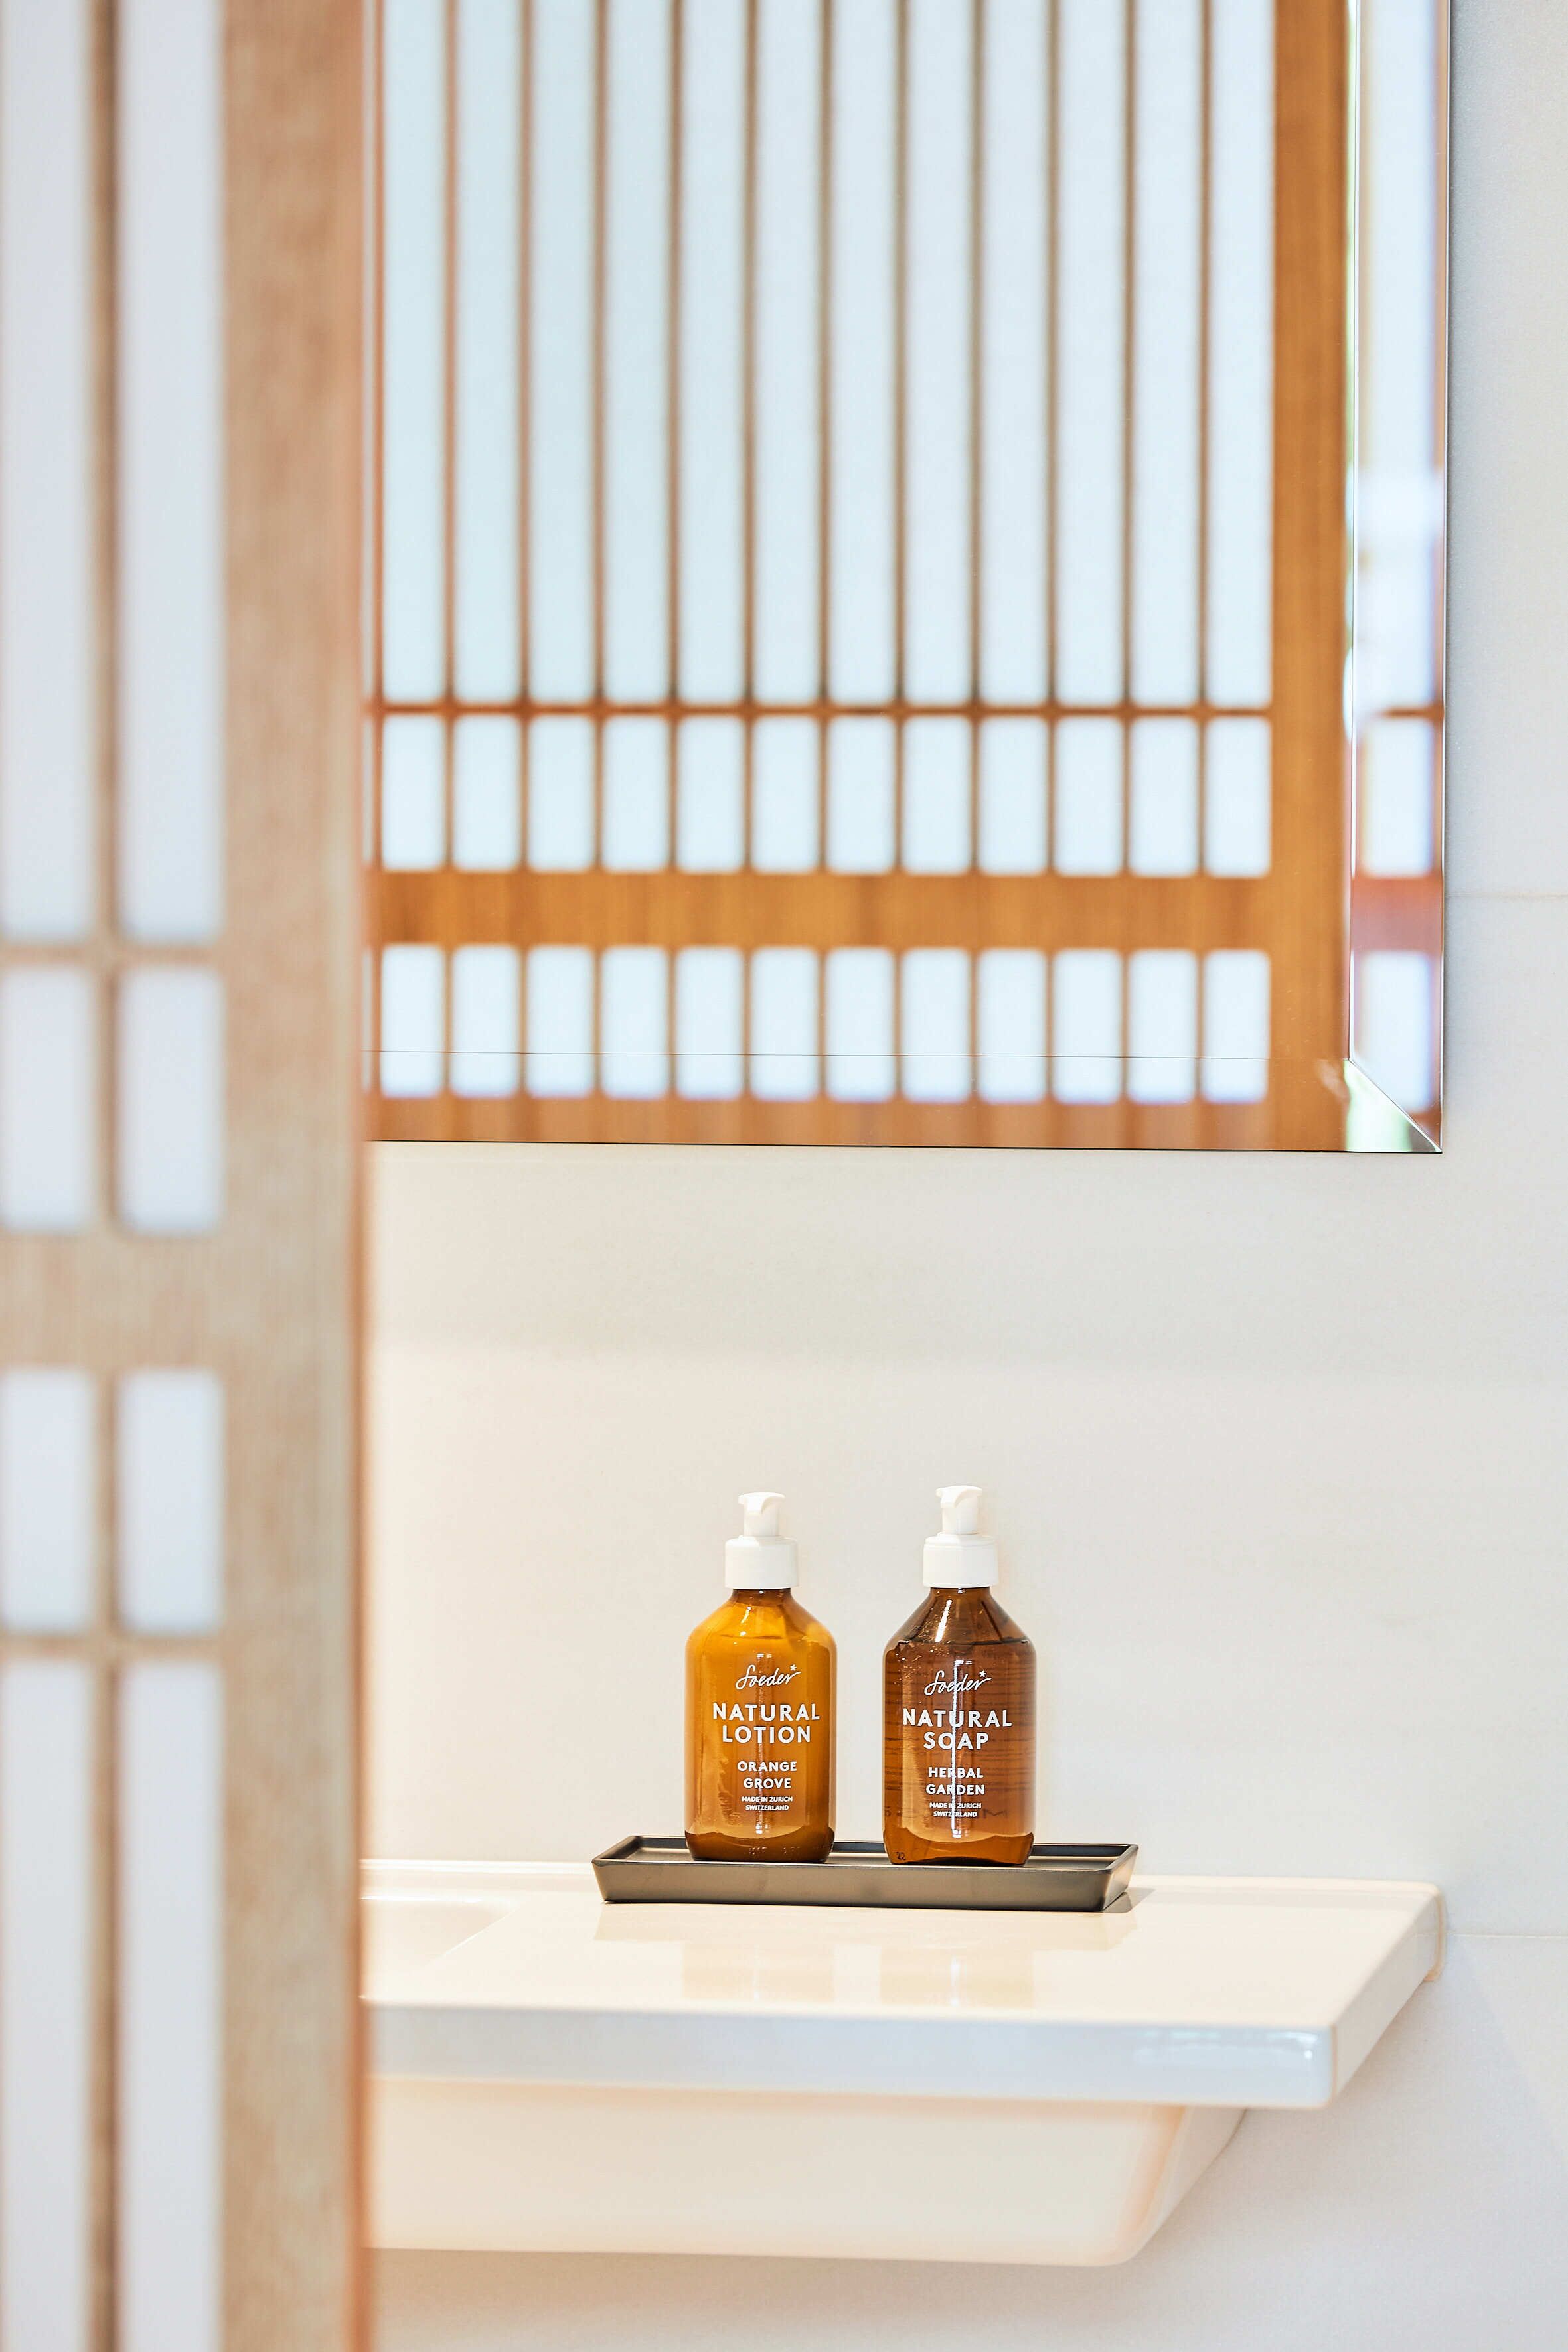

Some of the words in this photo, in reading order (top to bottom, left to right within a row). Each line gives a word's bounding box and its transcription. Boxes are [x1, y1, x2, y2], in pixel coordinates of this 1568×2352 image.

[712, 1703, 820, 1721] NATURAL
[903, 1708, 1012, 1727] NATURAL
[722, 1725, 811, 1743] LOTION
[923, 1731, 989, 1750] SOAP
[737, 1761, 797, 1772] ORANGE
[928, 1766, 984, 1778] HERBAL
[743, 1778, 792, 1789] GROVE
[926, 1784, 985, 1796] GARDEN
